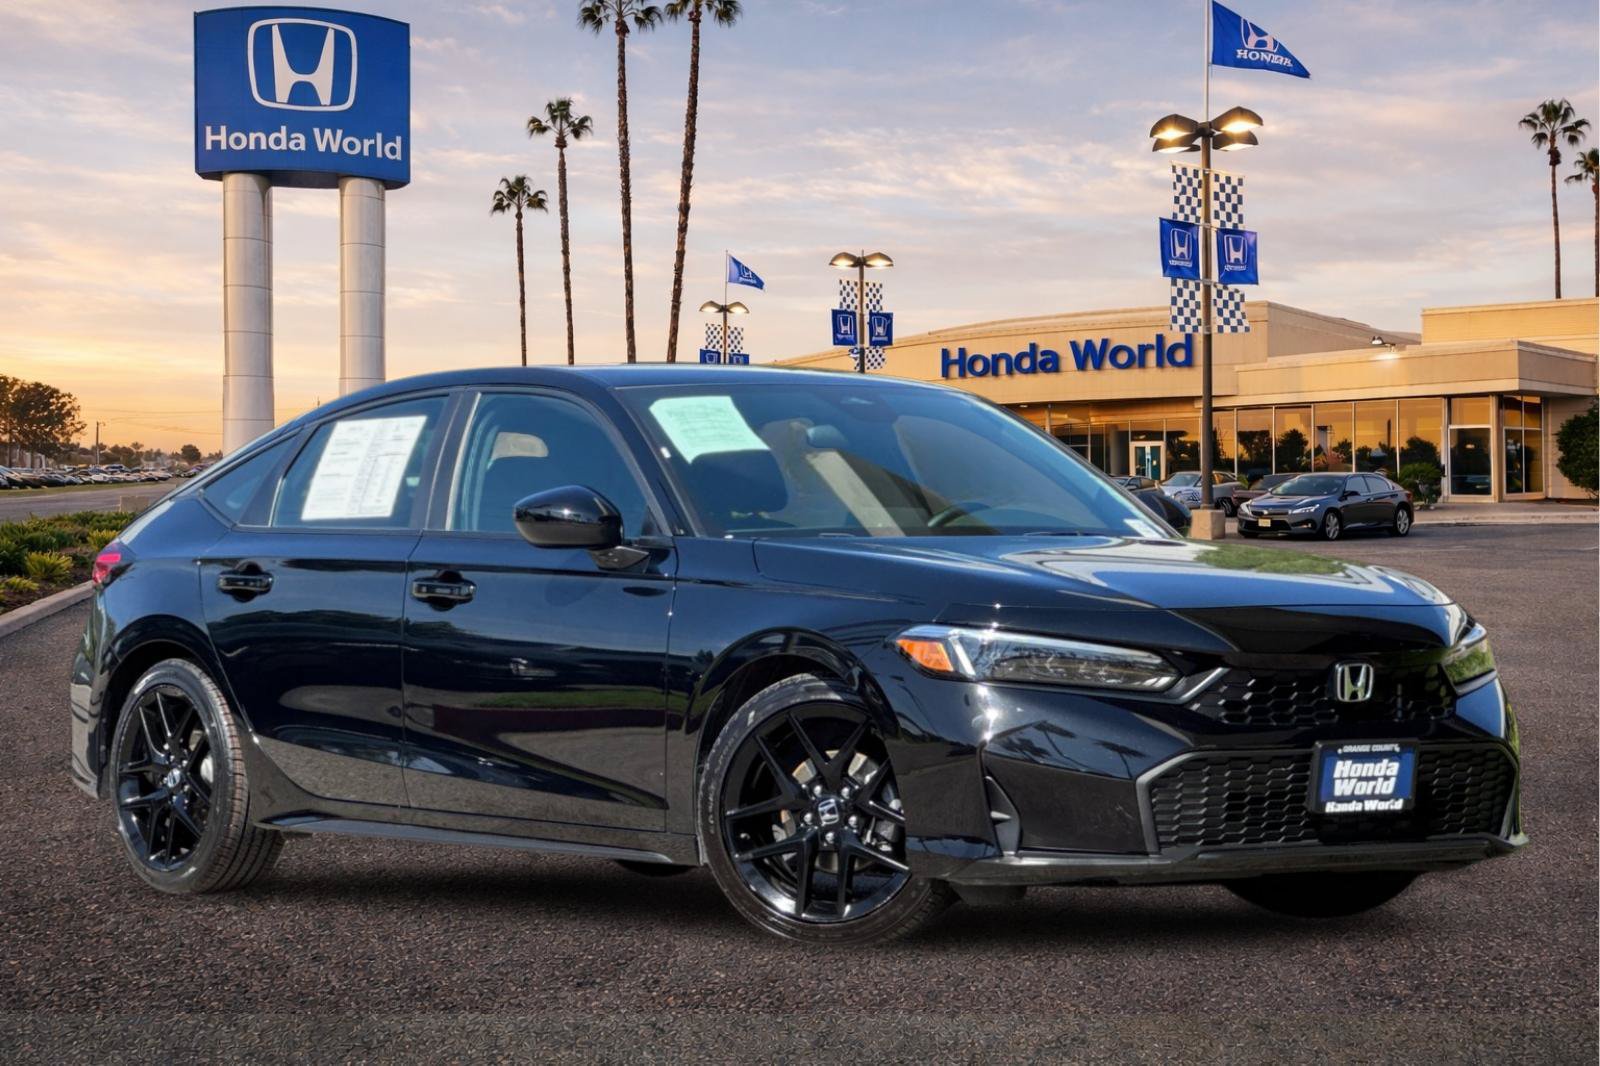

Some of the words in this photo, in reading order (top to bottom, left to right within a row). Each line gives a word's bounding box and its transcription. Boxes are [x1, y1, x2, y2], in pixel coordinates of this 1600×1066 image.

[204, 125, 306, 151] Honda
[312, 127, 402, 161] World
[941, 342, 1061, 378] Honda
[1069, 333, 1194, 371] World
[1333, 758, 1400, 778] Honda
[1334, 777, 1397, 796] World
